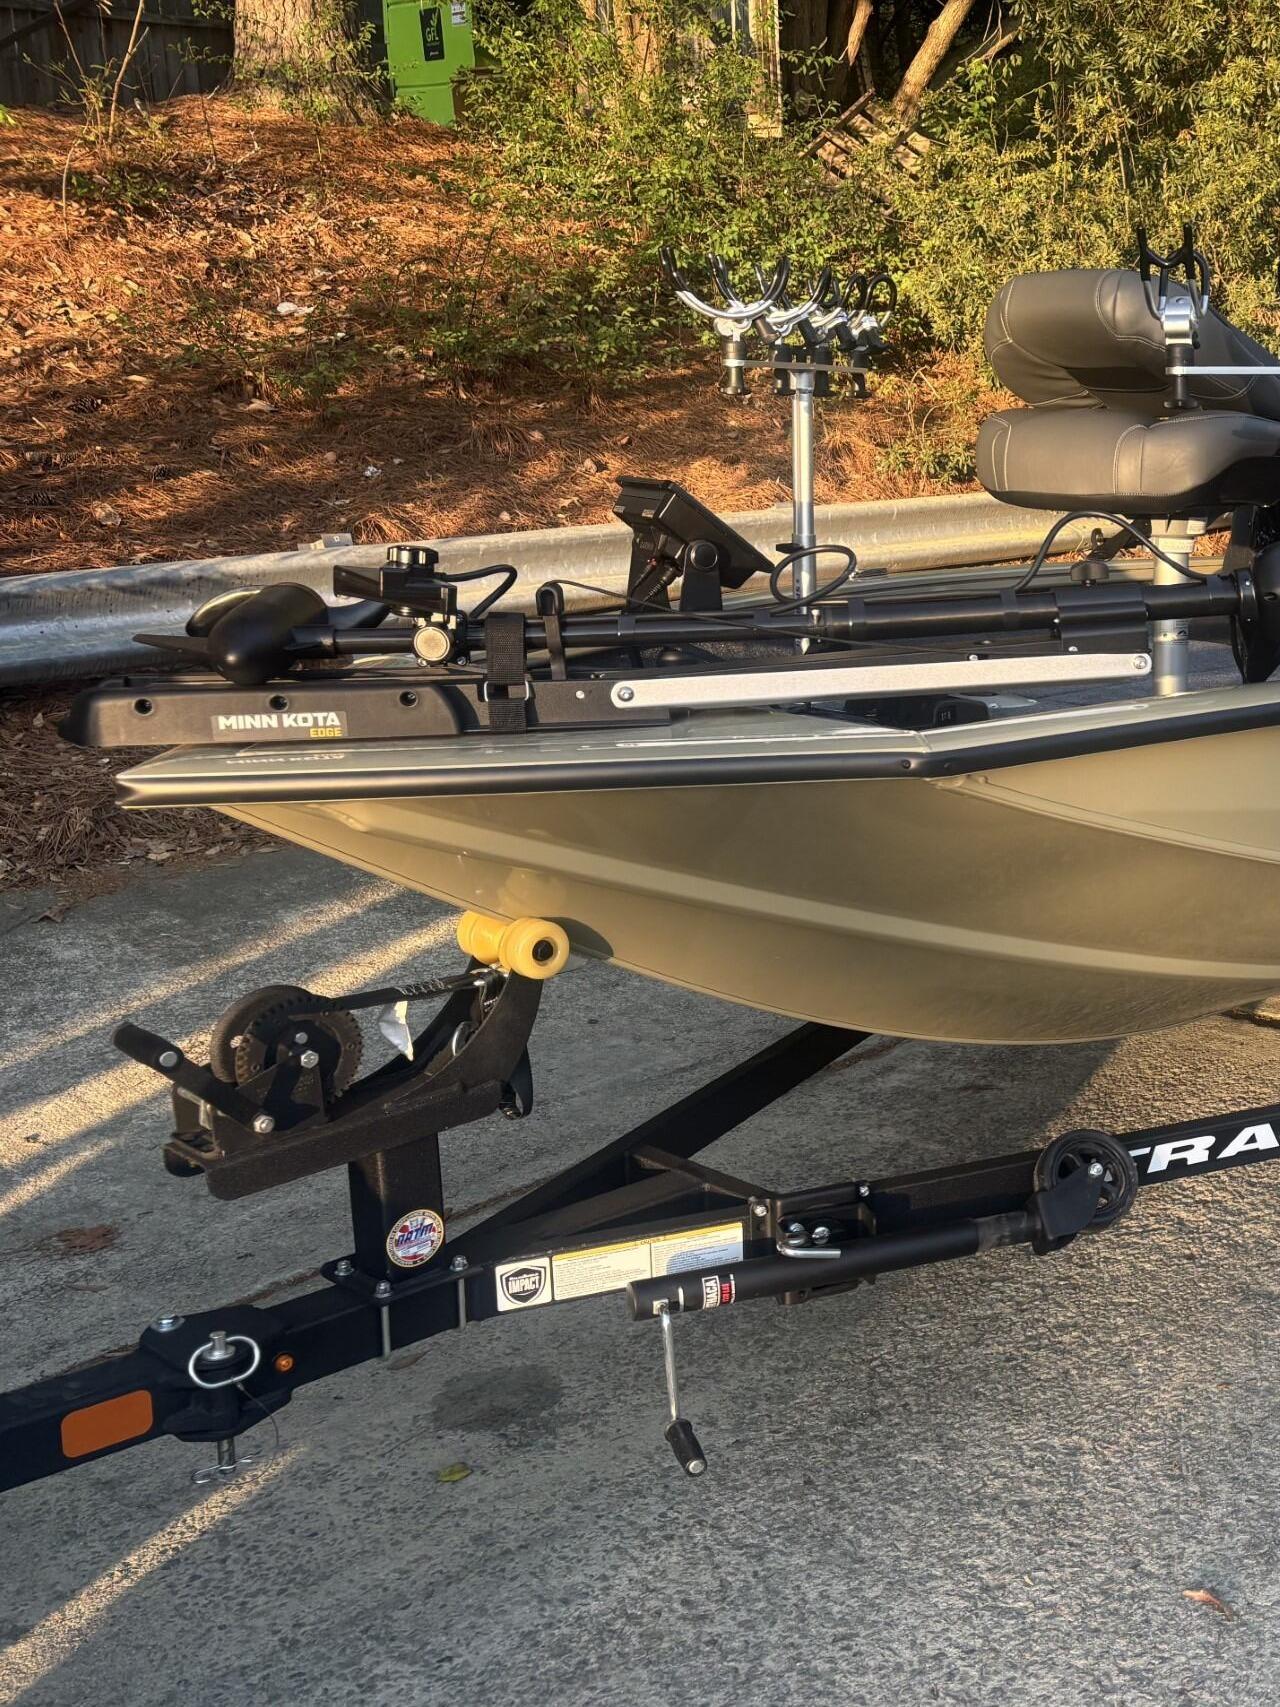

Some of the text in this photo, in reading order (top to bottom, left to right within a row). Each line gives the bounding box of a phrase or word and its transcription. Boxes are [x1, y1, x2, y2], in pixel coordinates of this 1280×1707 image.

[425, 27, 439, 42] GFL
[218, 712, 341, 730] MINN KOTA
[309, 727, 343, 738] EDGE
[508, 1275, 541, 1295] IMPACT
